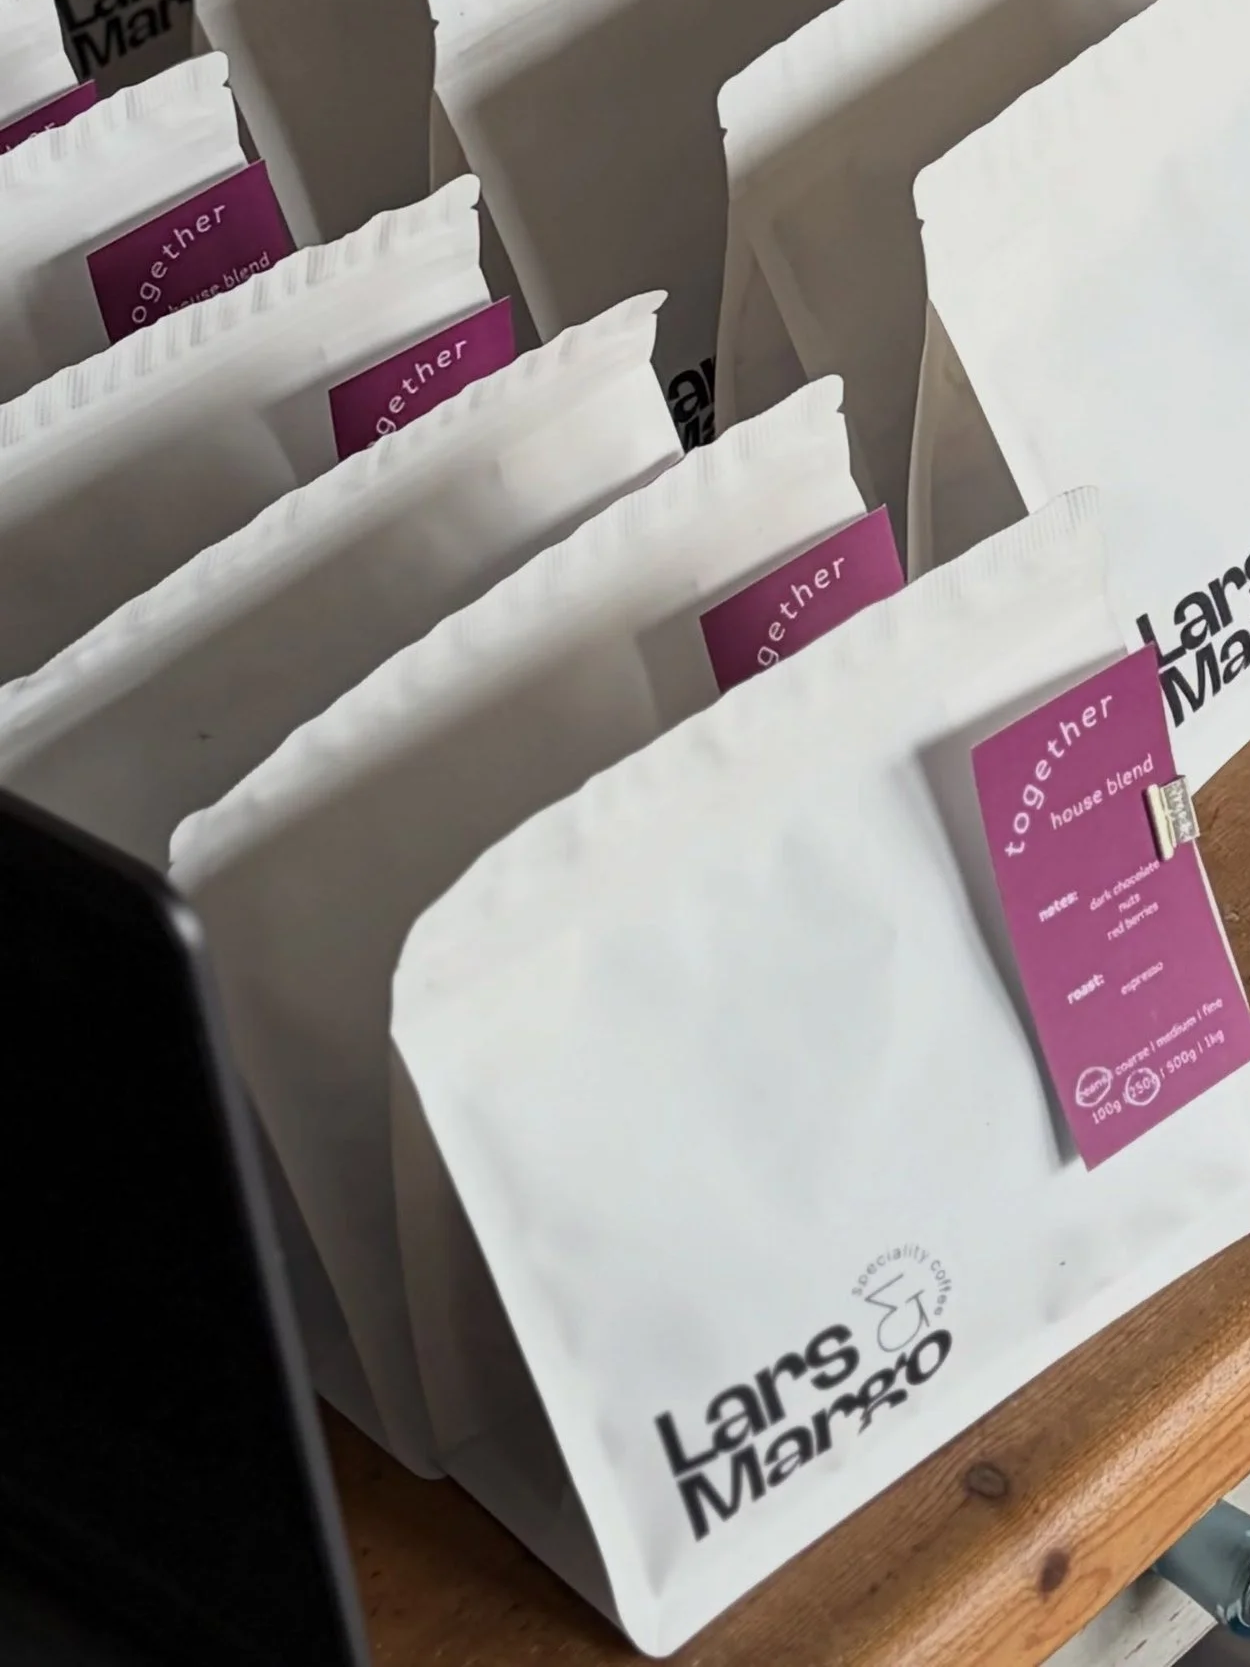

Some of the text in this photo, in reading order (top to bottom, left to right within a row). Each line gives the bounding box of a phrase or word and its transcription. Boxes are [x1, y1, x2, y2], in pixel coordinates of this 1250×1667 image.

[131, 204, 226, 324] ogether
[222, 251, 270, 288] blend
[368, 340, 467, 447] gether
[757, 556, 846, 667] gether
[1005, 695, 1112, 857] together
[1051, 753, 1154, 830] house blend
[1039, 859, 1160, 922] notes: dark chocolate
[1107, 902, 1159, 940] red berries
[1118, 893, 1141, 912] nuts
[1067, 961, 1163, 1005] roast: espresso
[1115, 1047, 1150, 1075] coarse
[1156, 1016, 1196, 1047] medium
[1202, 998, 1223, 1016] fine
[1092, 1100, 1122, 1124] 100g
[1166, 1049, 1197, 1073] 500g
[1204, 1030, 1225, 1048] 1kg
[852, 1242, 952, 1317] speciality coffee
[655, 1323, 860, 1478] Lars
[677, 1329, 953, 1542] Margo
